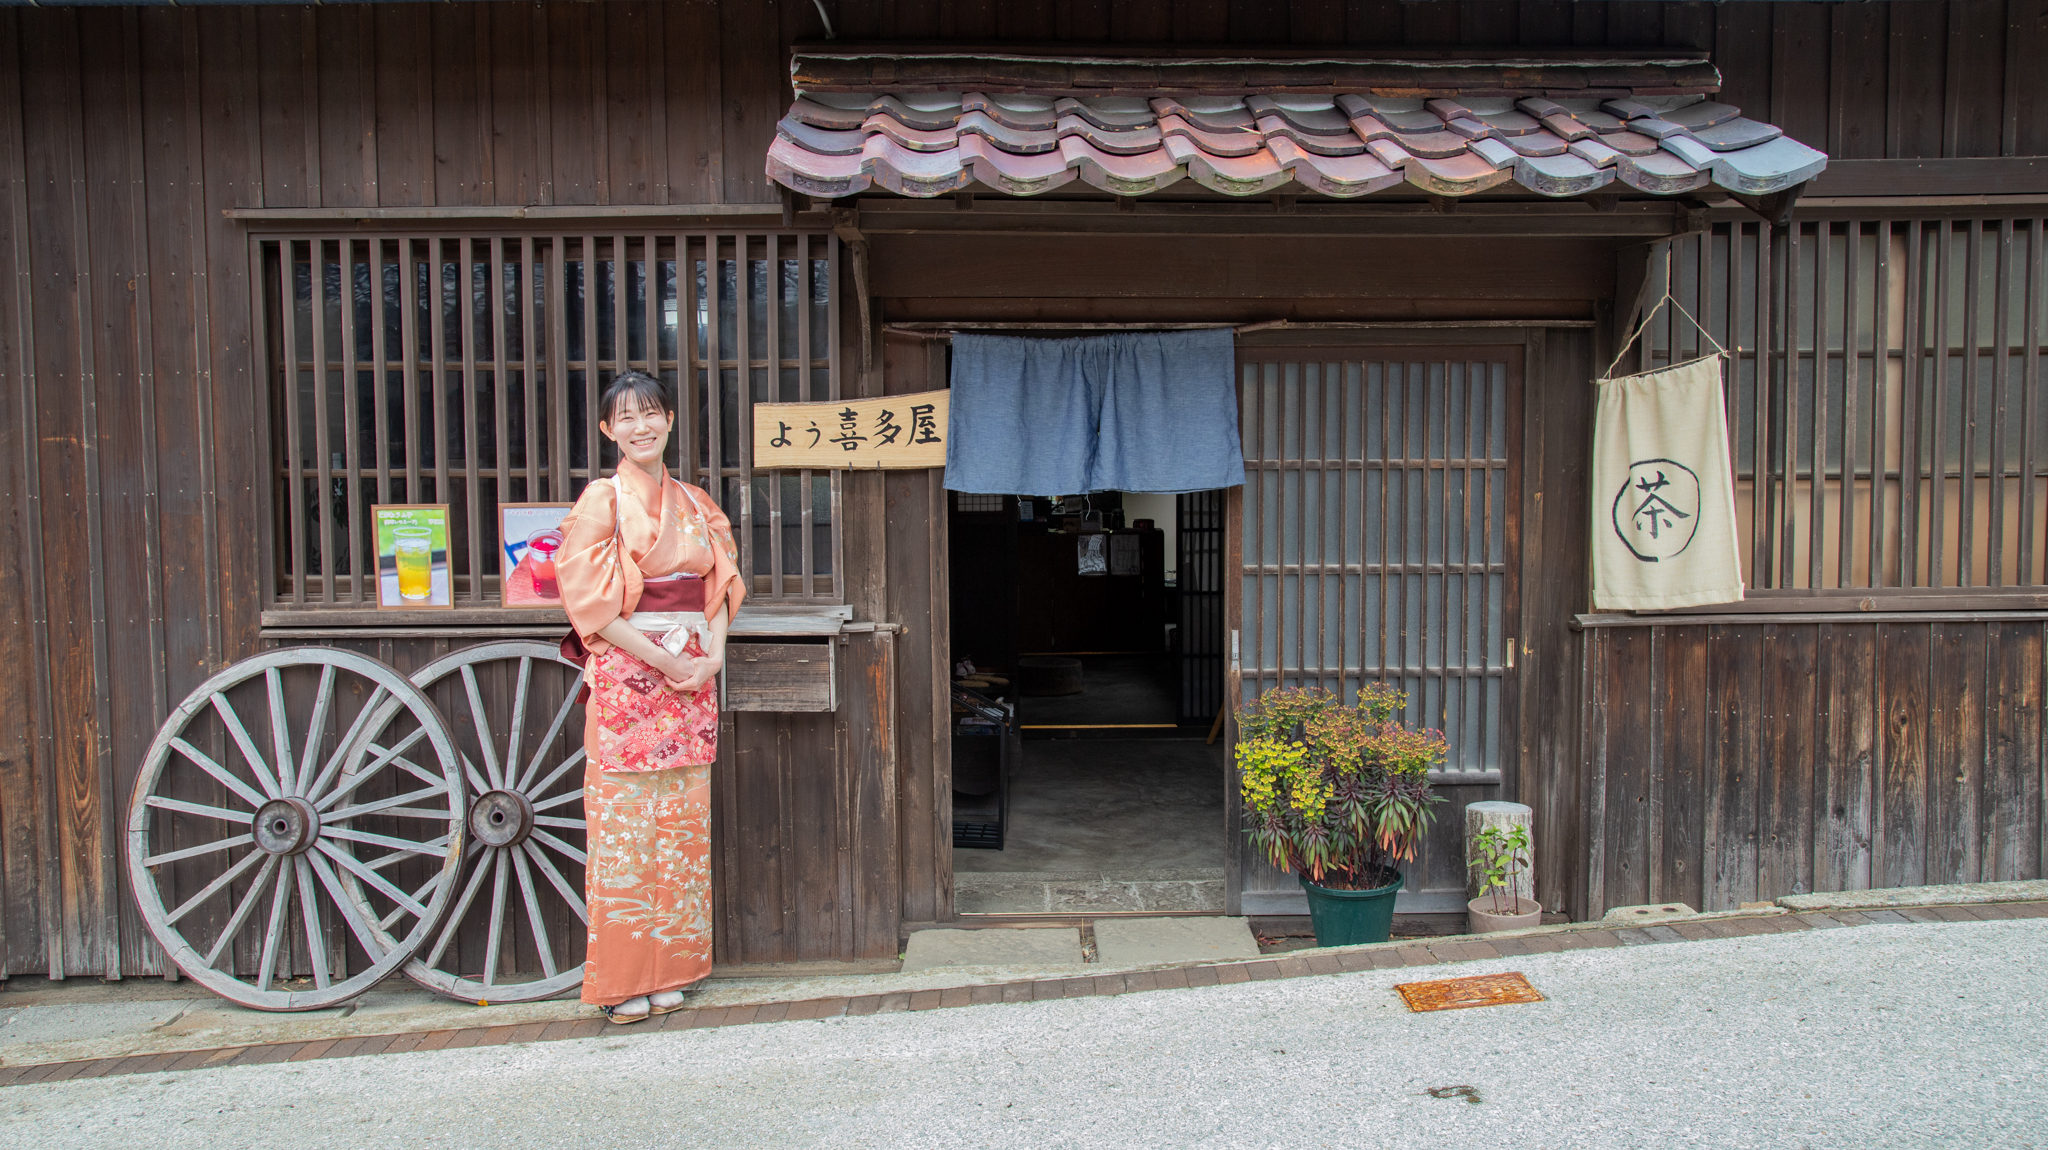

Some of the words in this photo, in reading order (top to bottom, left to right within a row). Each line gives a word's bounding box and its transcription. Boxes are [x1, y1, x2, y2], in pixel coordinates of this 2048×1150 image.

[770, 404, 942, 451] よう喜多屋
[1632, 470, 1691, 540] 茶
